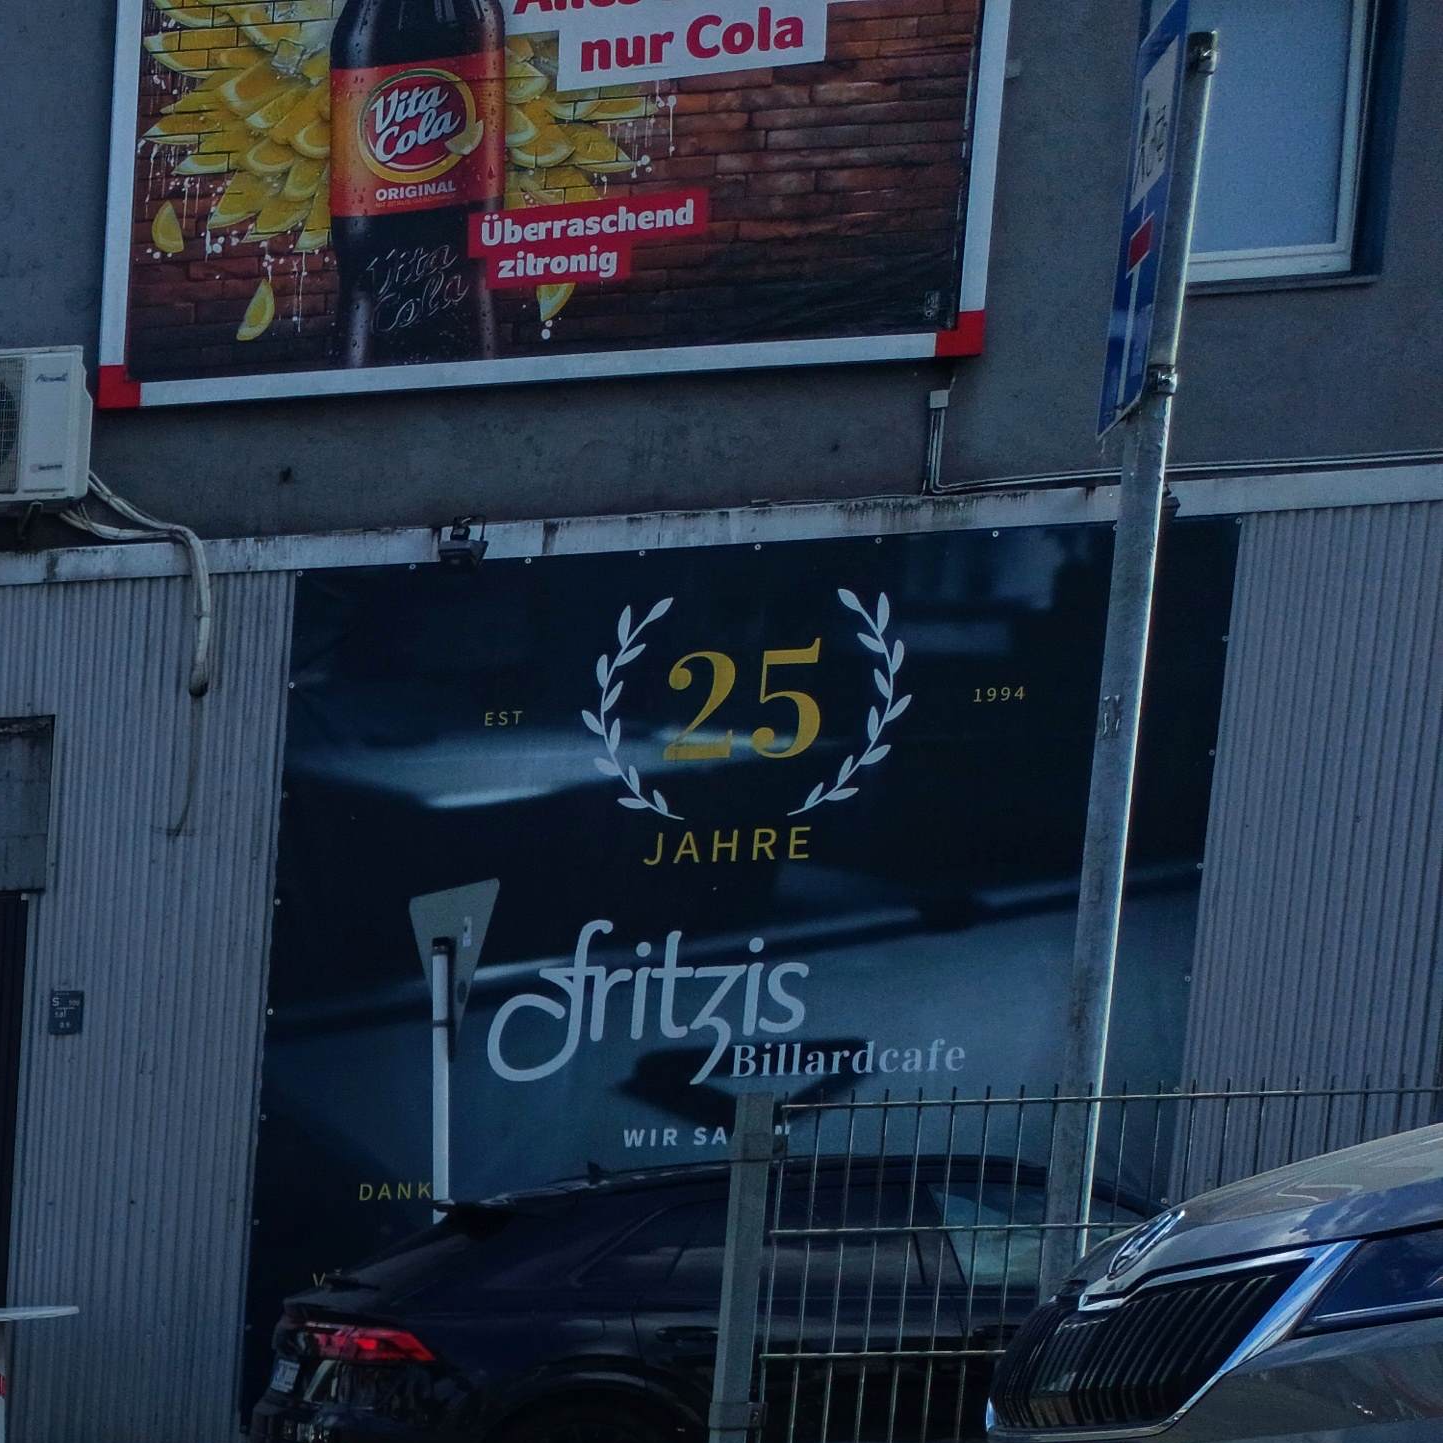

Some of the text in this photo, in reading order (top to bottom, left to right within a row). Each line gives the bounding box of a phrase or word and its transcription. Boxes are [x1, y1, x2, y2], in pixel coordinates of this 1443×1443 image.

[581, 6, 804, 73] nur Cola
[372, 80, 449, 134] Vita
[375, 106, 461, 164] Cola
[375, 180, 457, 202] ORIGINAL
[481, 199, 695, 246] Überraschend
[497, 246, 617, 281] zitronig
[663, 638, 822, 761] 25
[973, 685, 1026, 703] 1994
[483, 710, 523, 727] EST
[644, 826, 813, 866] JAHRE
[487, 919, 810, 1085] fritzis
[730, 1039, 965, 1079] Billardcafe
[623, 1127, 678, 1148] WIR
[358, 1181, 433, 1201] DANK
